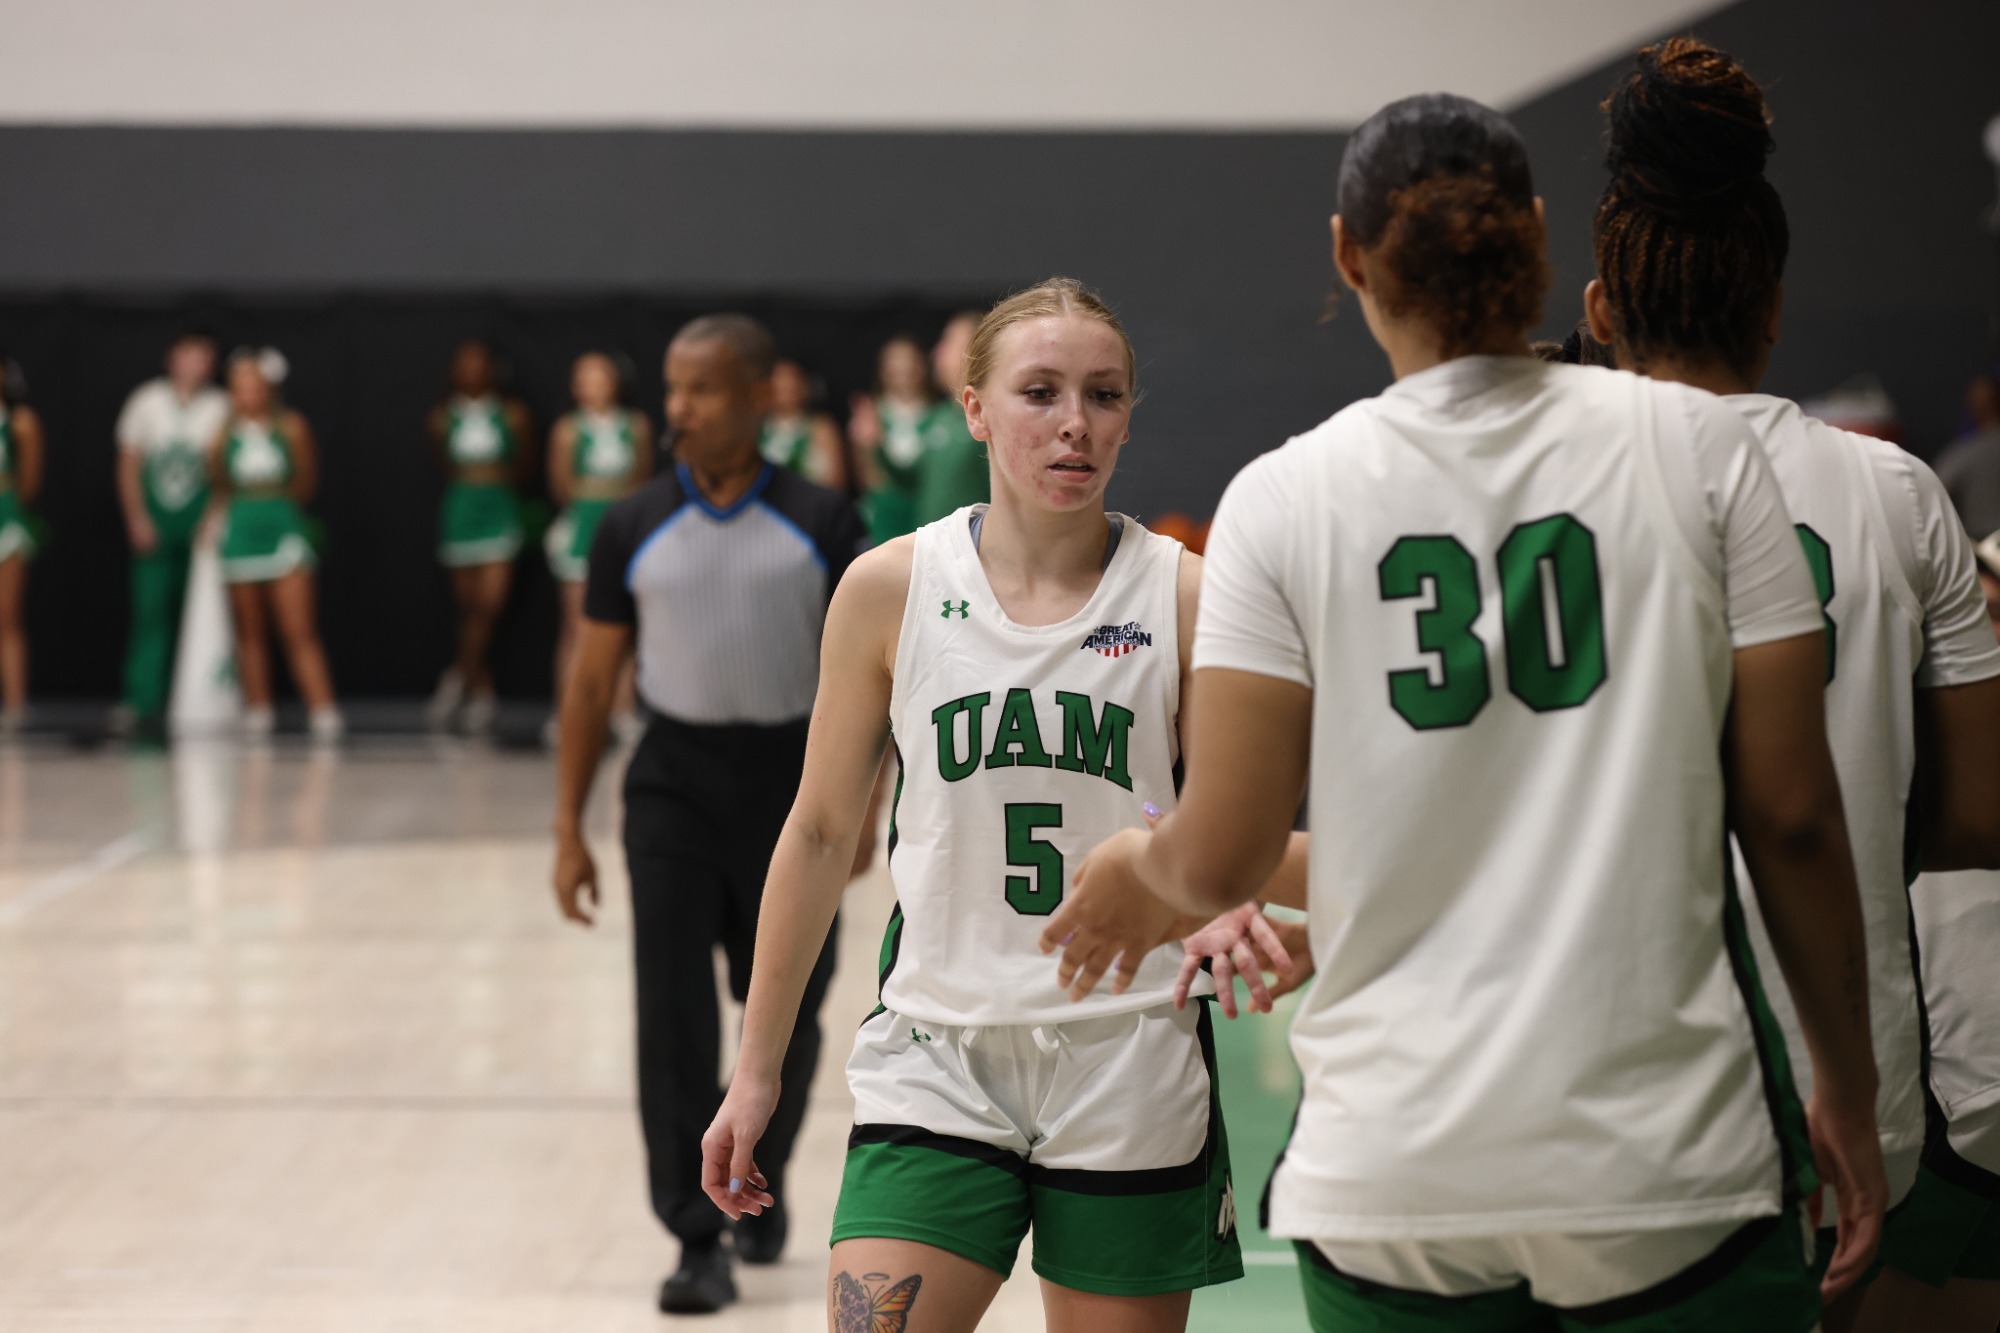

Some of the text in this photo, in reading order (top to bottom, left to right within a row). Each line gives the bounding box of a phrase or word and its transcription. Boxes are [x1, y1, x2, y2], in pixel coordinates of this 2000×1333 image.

[1080, 631, 1152, 649] AMERICAN
[1100, 621, 1135, 635] GREAT
[1377, 512, 1608, 730] 30
[932, 688, 1134, 793] UAM
[1005, 803, 1063, 915] 5
